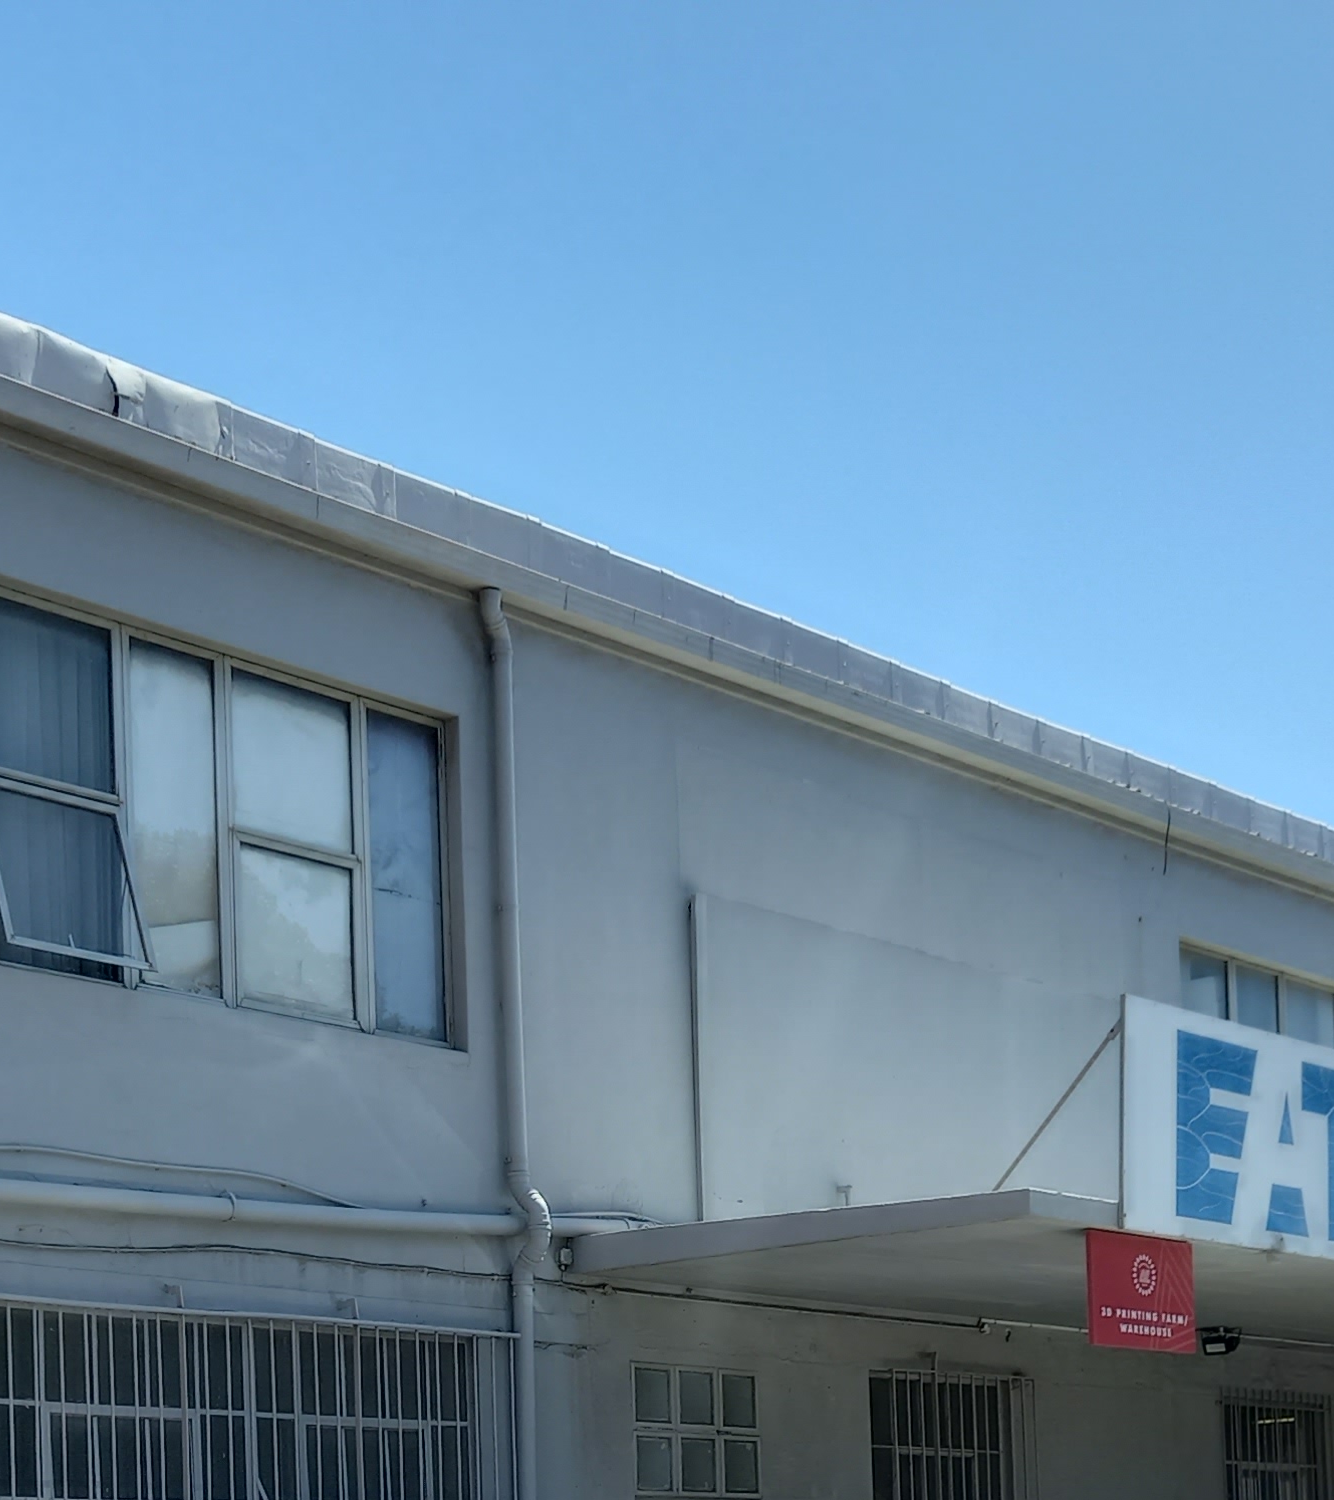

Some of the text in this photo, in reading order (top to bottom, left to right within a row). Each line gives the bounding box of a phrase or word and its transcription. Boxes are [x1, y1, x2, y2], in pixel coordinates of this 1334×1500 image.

[1101, 1306, 1113, 1317] 3D
[1116, 1308, 1158, 1322] PRINTING
[1120, 1323, 1172, 1337] WAREHOUSE
